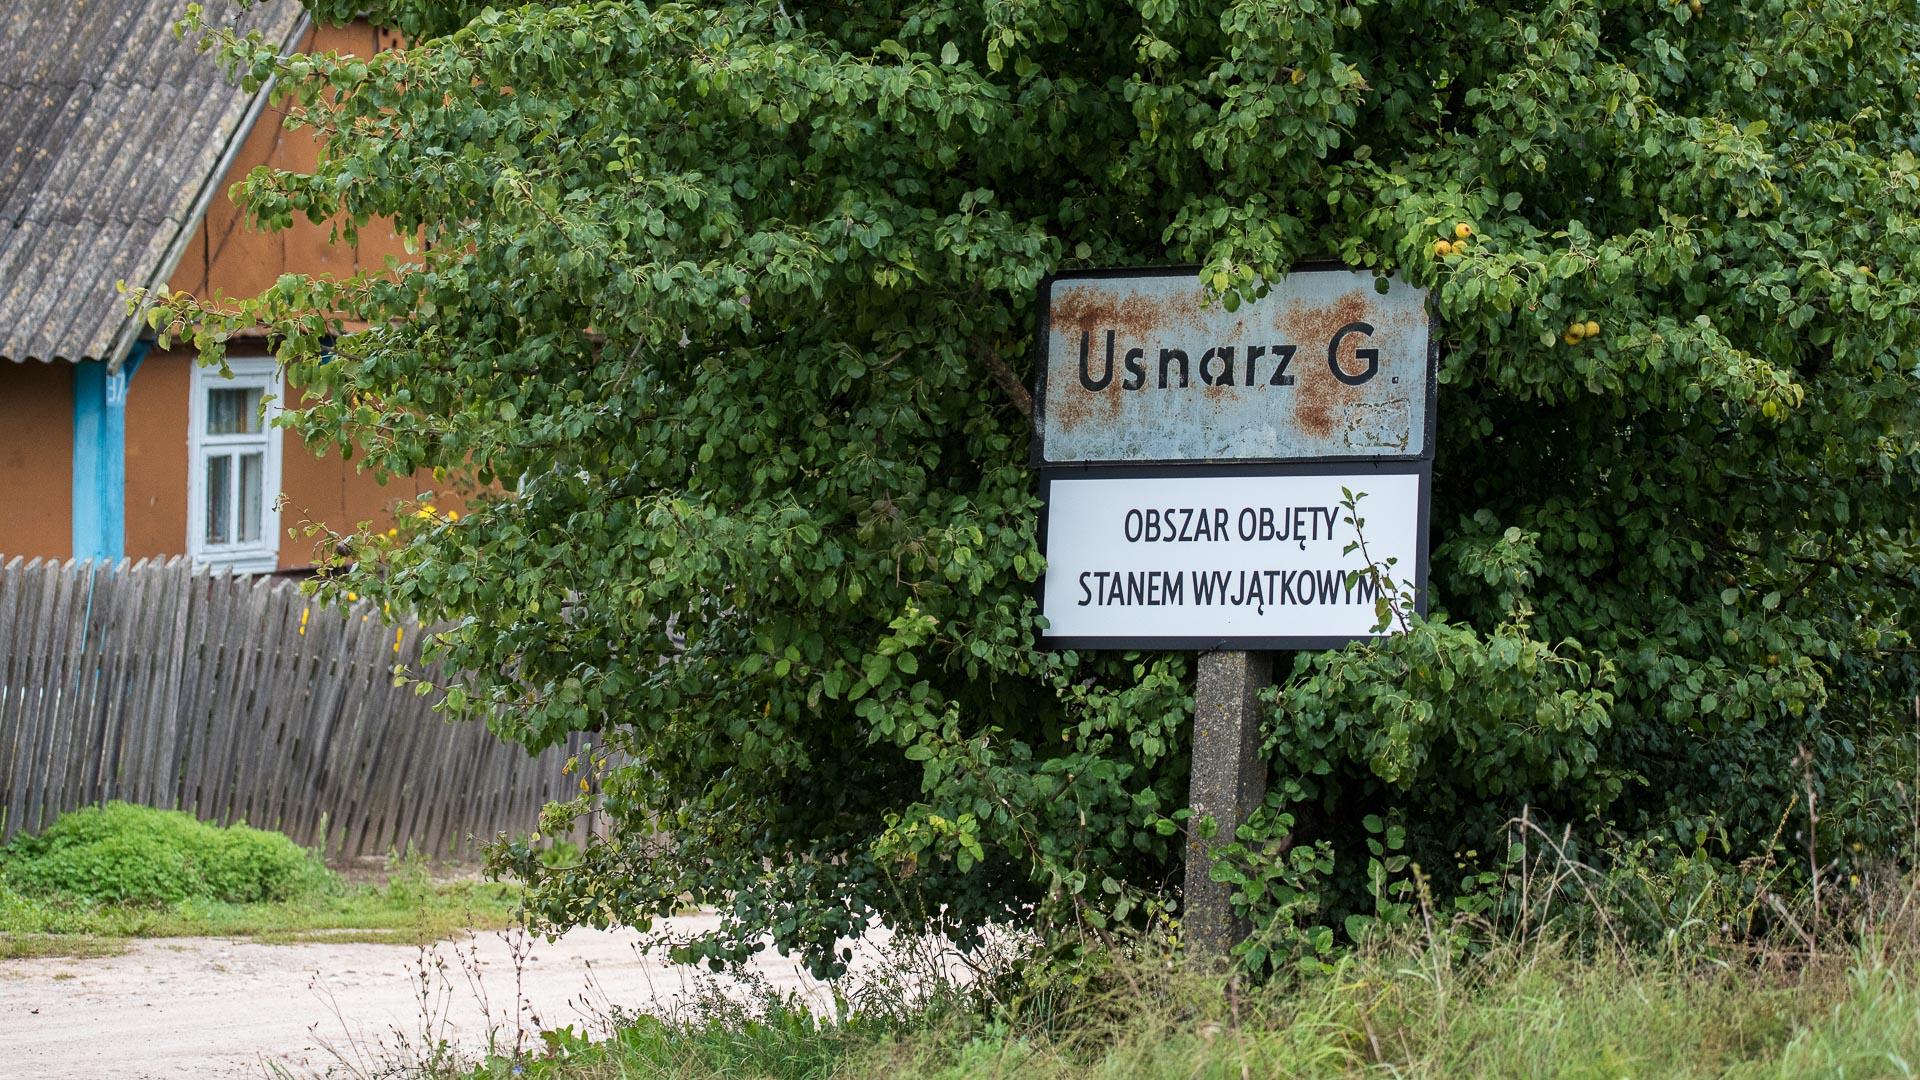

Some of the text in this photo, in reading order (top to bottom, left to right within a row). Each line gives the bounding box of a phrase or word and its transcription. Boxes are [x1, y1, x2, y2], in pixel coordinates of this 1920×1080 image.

[1079, 322, 1398, 391] Usnarz G.
[1124, 506, 1339, 550] OBSZAR OBJĘTY
[1078, 570, 1380, 616] STANEM WYJĄTKOWYM
